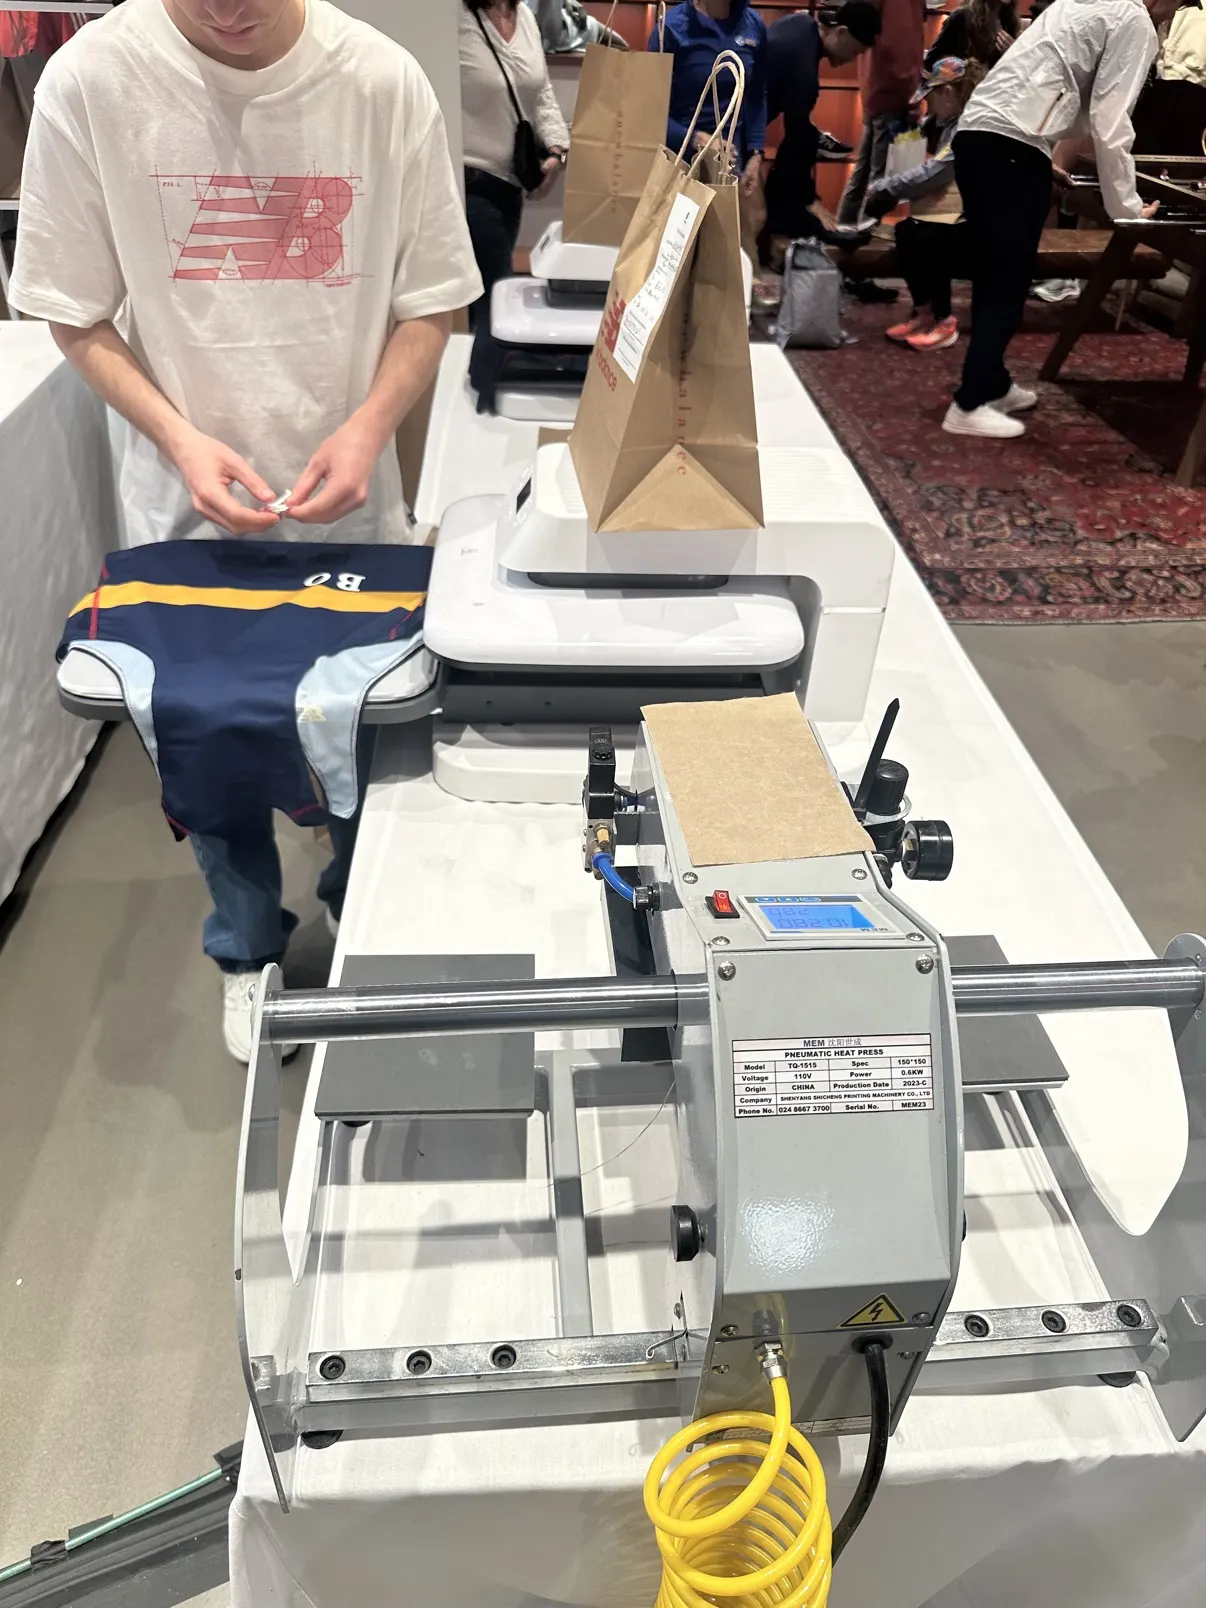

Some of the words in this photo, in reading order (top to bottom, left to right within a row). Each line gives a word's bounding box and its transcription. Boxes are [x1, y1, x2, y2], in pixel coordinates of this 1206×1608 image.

[803, 1039, 825, 1047] MEM
[834, 1049, 856, 1057] HEAT
[738, 1107, 760, 1115] Phone
